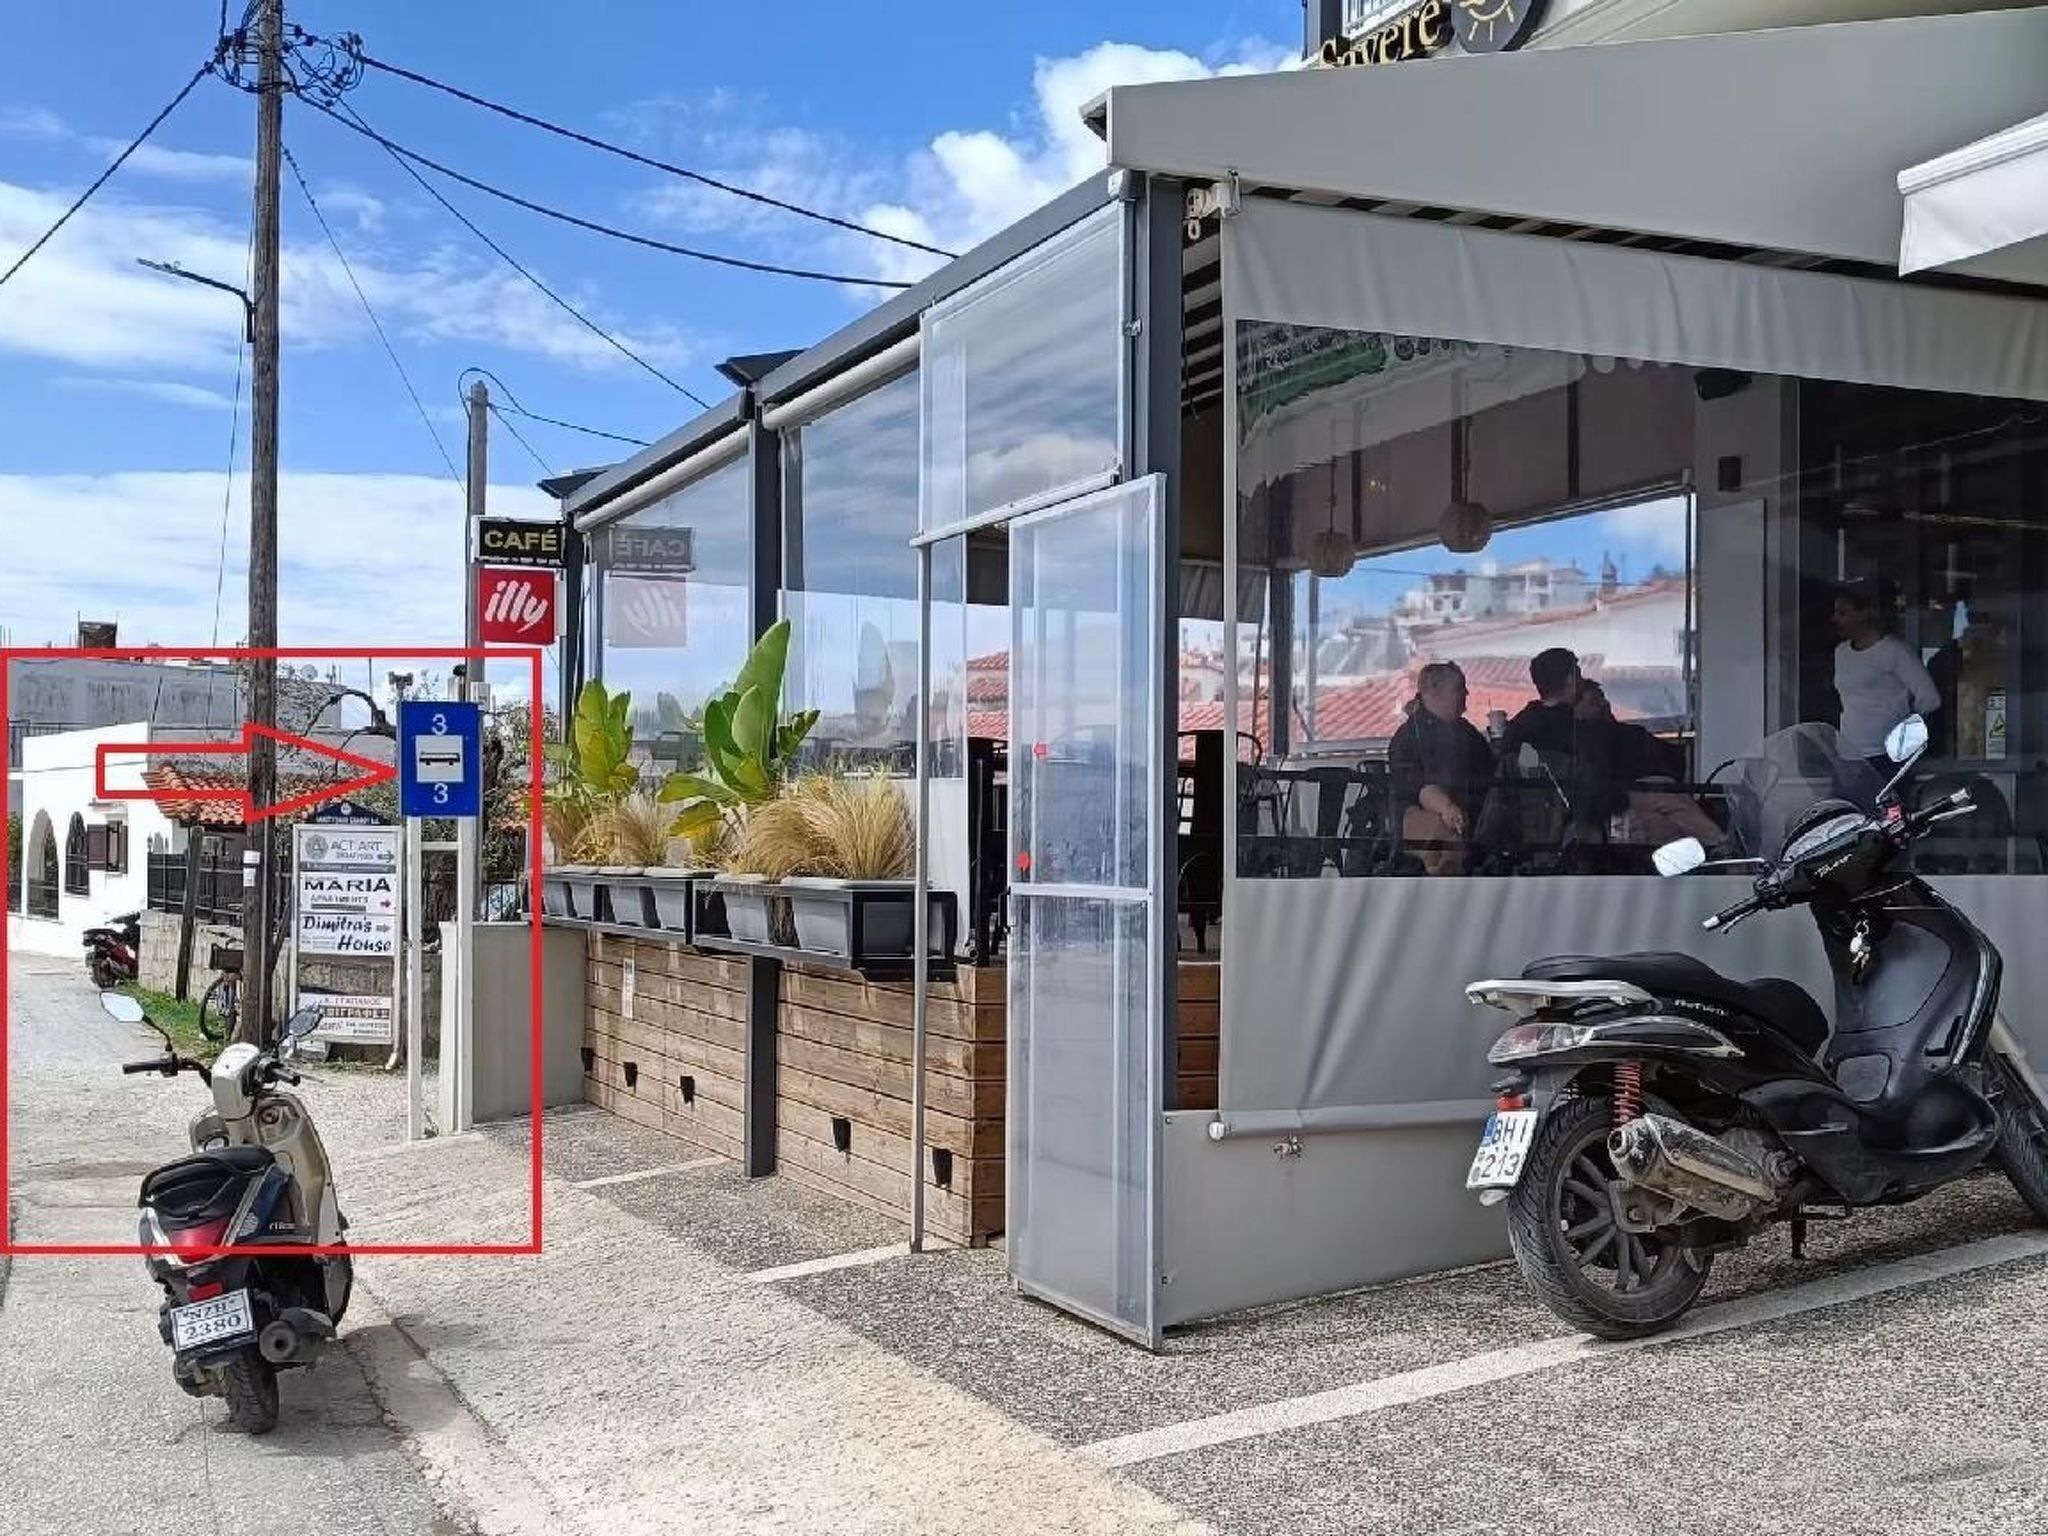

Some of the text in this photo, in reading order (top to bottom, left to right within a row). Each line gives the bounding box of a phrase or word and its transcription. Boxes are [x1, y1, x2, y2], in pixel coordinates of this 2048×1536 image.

[485, 529, 557, 551] CAFÉ
[484, 580, 549, 632] illy
[432, 714, 448, 734] 3
[433, 783, 448, 803] 3
[304, 878, 392, 893] MARIA
[303, 915, 372, 933] Dimitra's
[337, 935, 392, 953] House
[1480, 1152, 1520, 1178] 213
[185, 1315, 242, 1340] 2380
